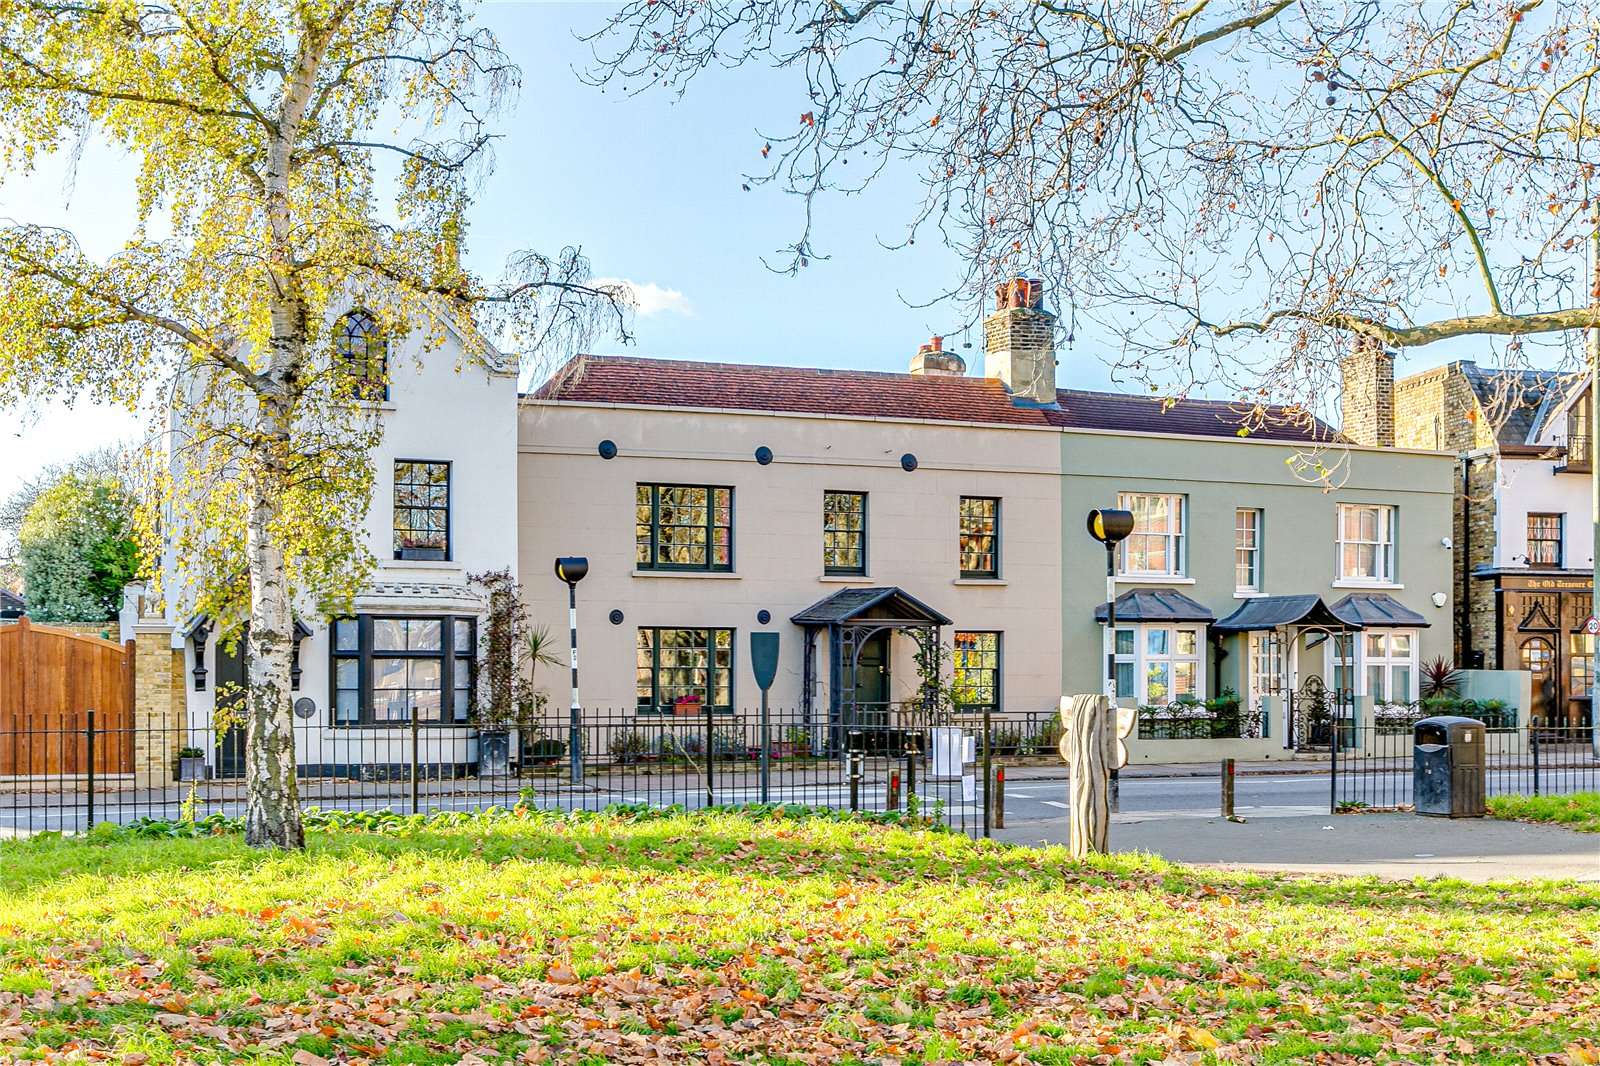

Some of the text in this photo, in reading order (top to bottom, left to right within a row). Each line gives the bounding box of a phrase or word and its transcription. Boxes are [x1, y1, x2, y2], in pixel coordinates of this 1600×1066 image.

[1527, 580, 1541, 589] The
[1542, 580, 1555, 588] Old
[1589, 622, 1598, 630] 20
